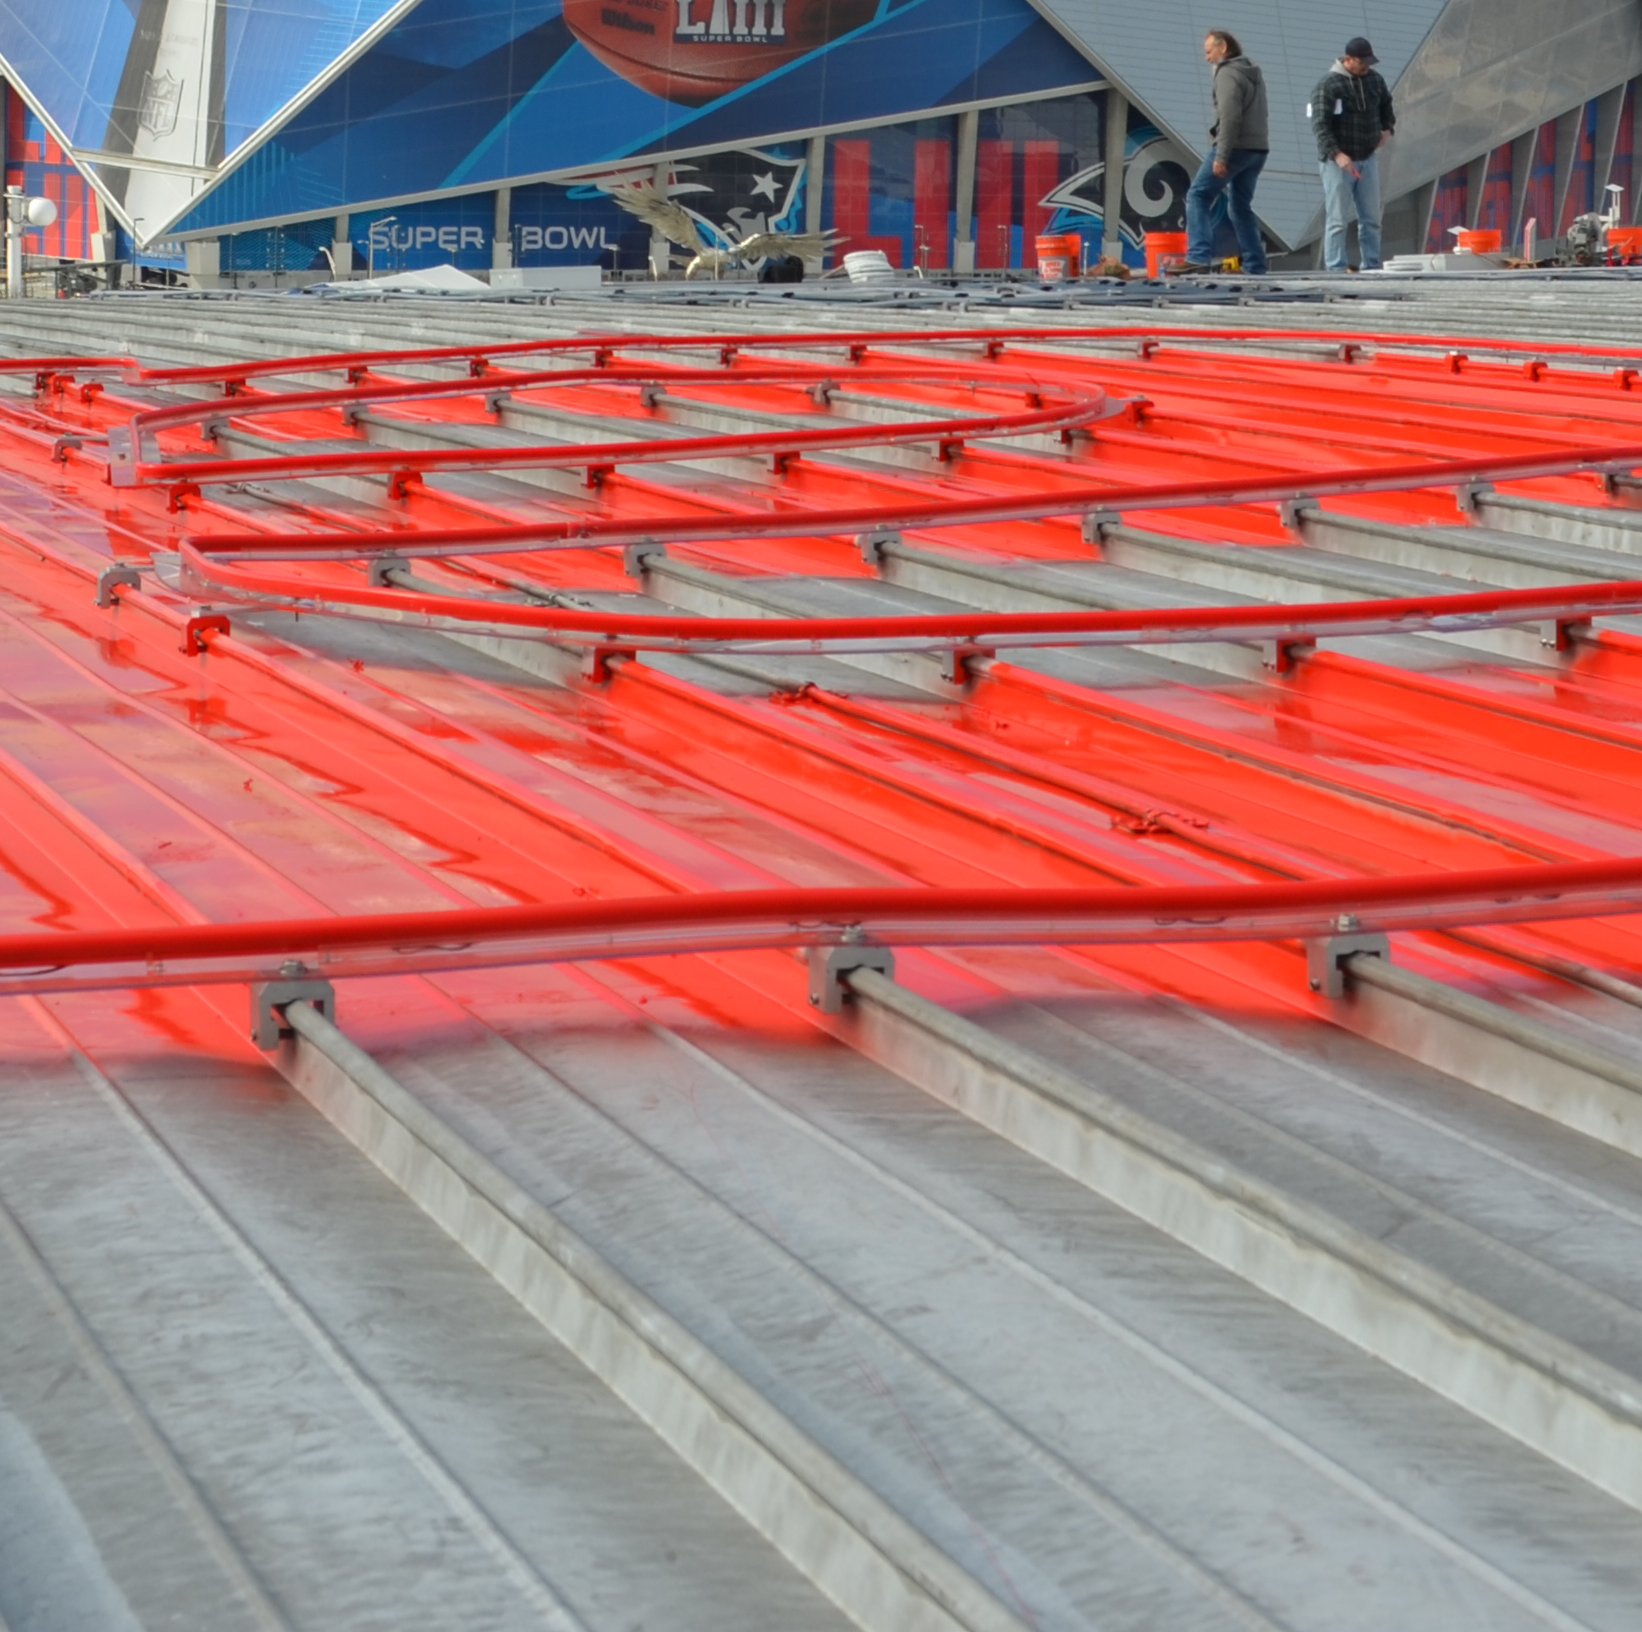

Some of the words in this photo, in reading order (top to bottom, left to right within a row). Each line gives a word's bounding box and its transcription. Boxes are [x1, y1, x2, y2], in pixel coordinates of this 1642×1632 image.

[693, 35, 732, 43] SUPER
[736, 35, 768, 44] BOWL
[368, 226, 483, 250] SUPER
[522, 226, 617, 250] BOWL
